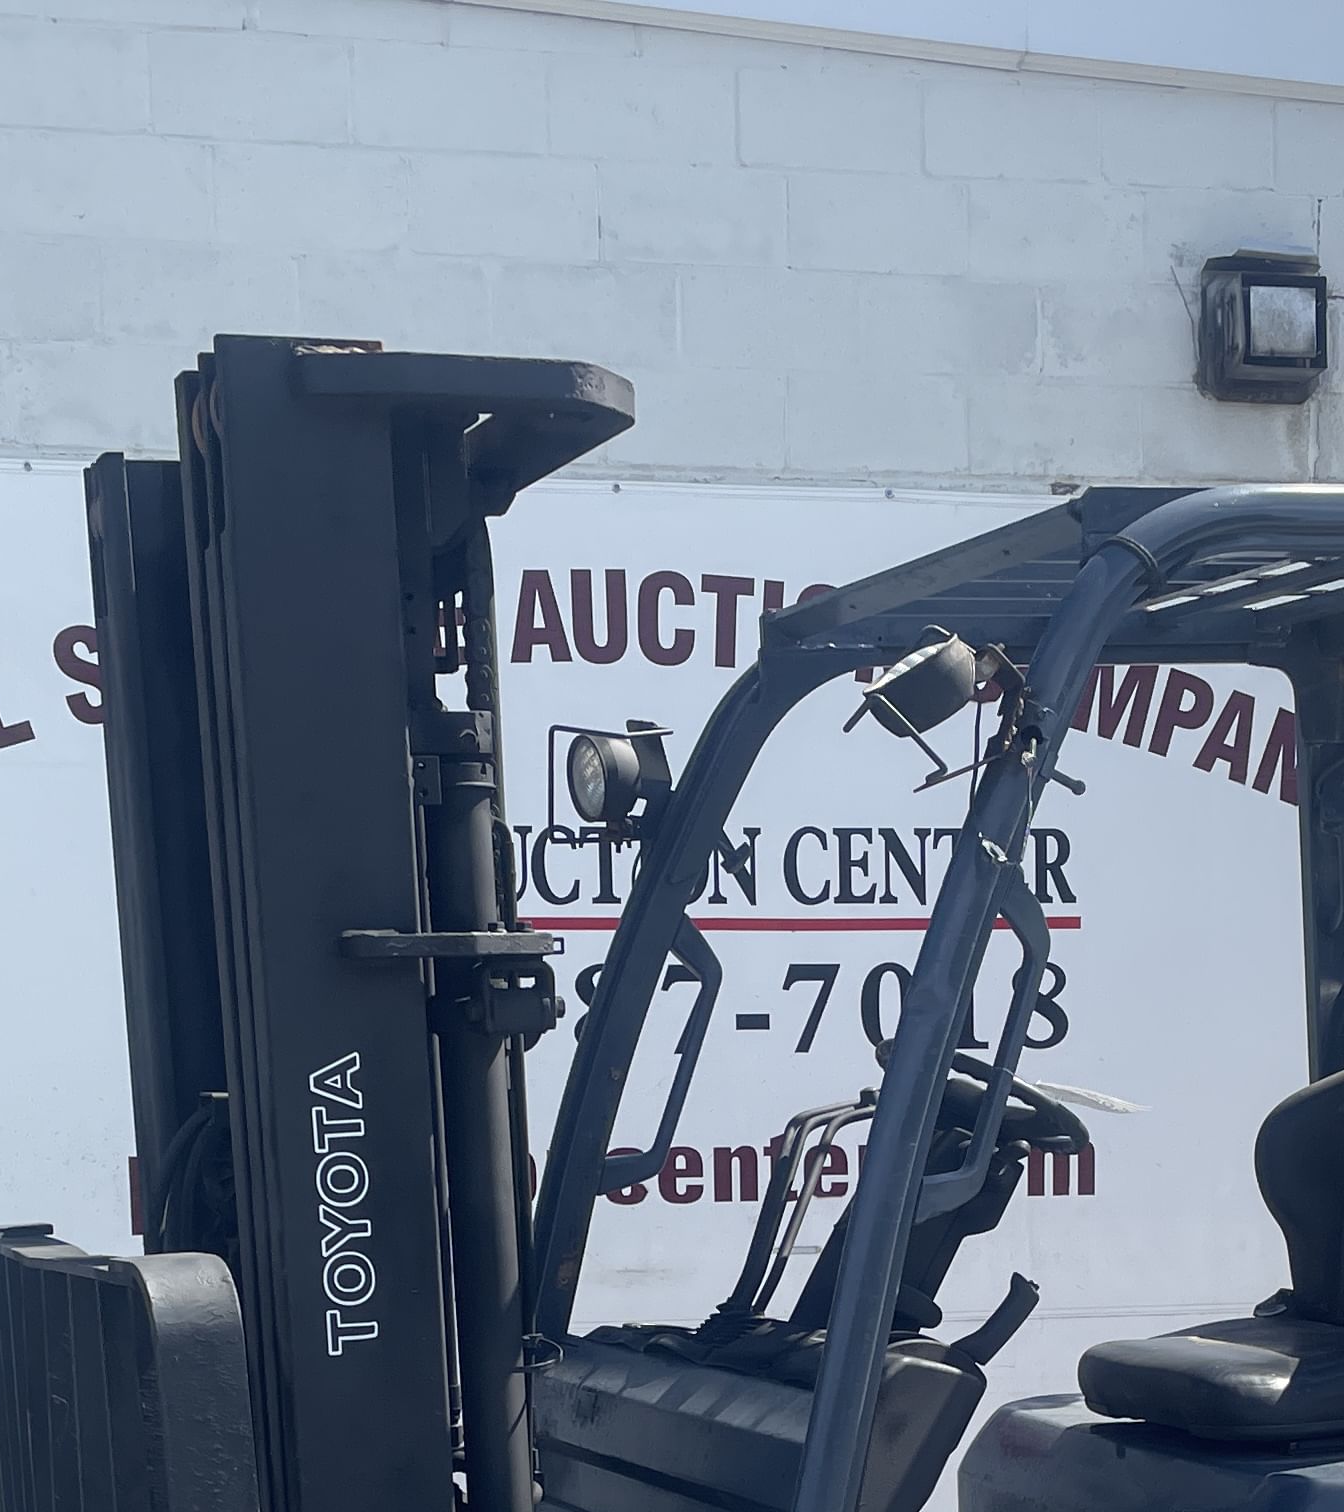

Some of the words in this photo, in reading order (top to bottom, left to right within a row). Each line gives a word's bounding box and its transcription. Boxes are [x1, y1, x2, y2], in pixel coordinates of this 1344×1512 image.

[510, 567, 882, 683] AUCT
[783, 826, 1077, 906] CENR
[309, 1051, 378, 1356] TOYOTA
